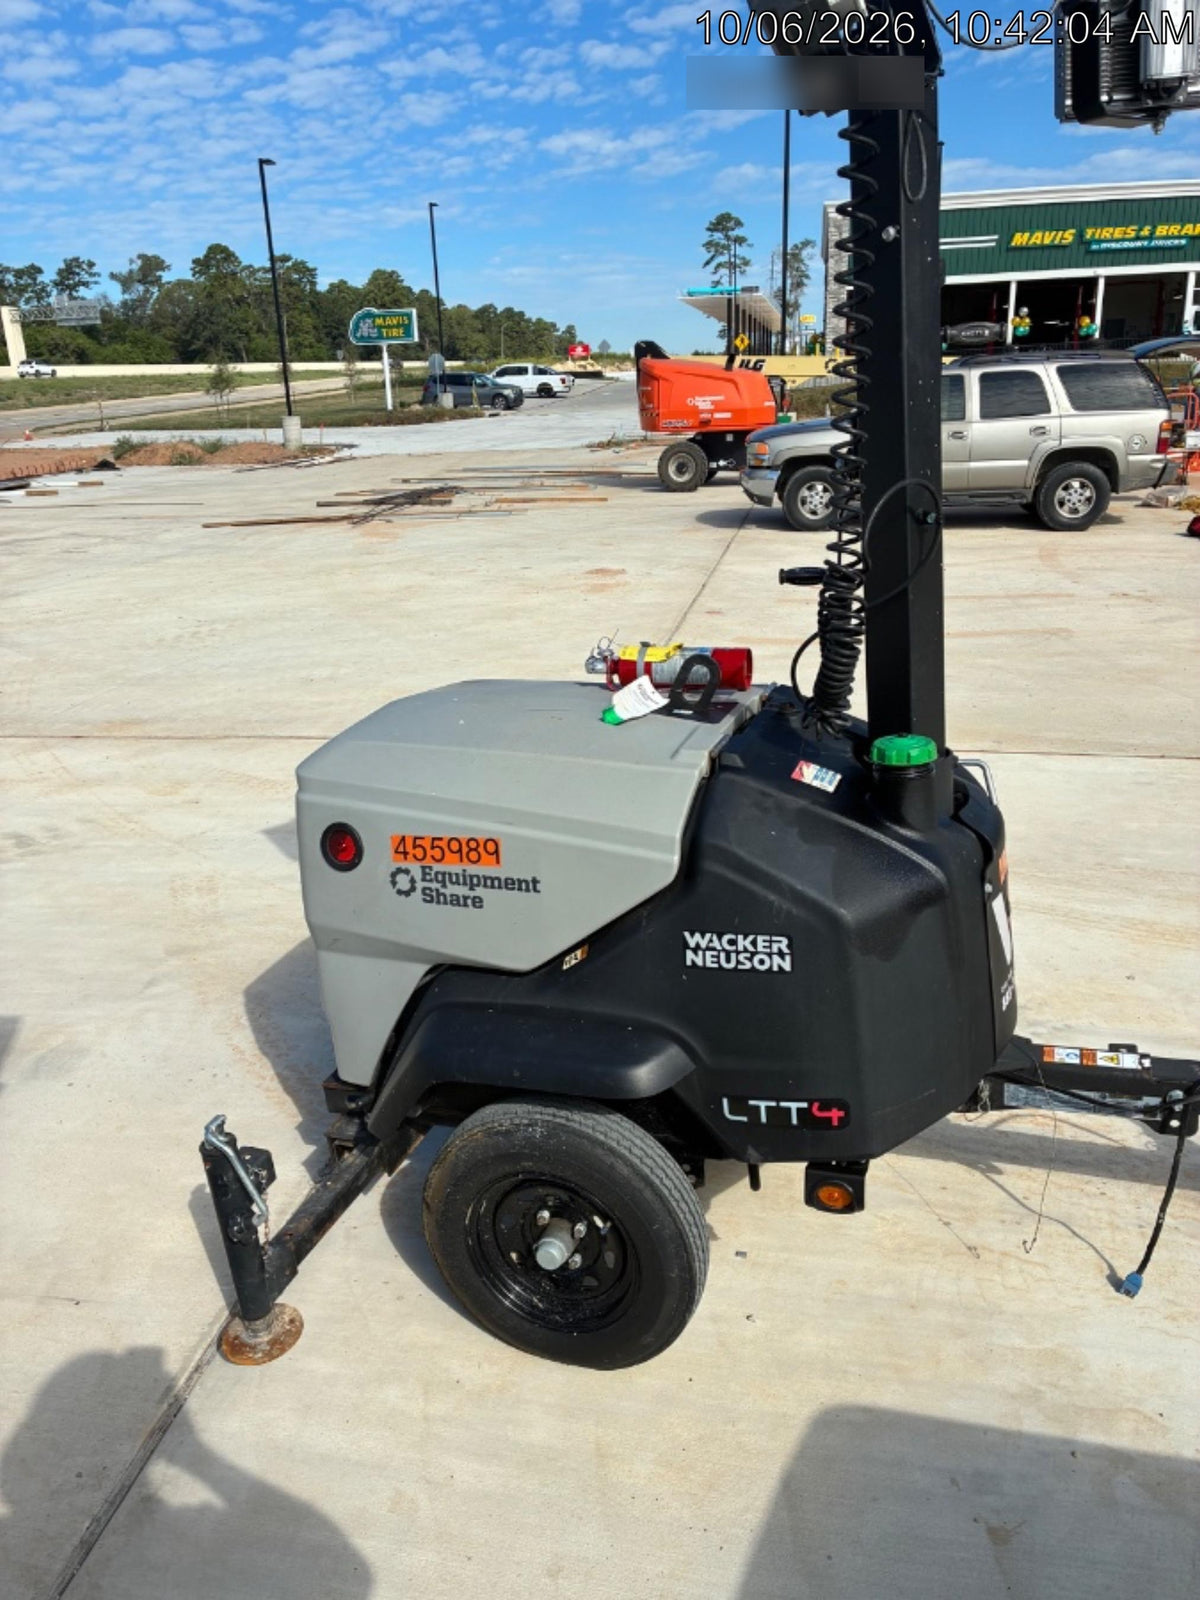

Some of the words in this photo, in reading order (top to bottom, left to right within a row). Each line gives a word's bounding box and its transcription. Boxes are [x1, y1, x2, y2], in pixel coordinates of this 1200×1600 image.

[1011, 229, 1076, 247] MAVIS
[1085, 226, 1138, 239] TIRES
[1140, 225, 1152, 236] &
[375, 316, 408, 326] MAVIS
[381, 327, 405, 338] TIRE
[394, 835, 500, 865] 455989
[420, 865, 541, 893] Equipment
[421, 886, 484, 909] Share
[683, 931, 790, 953] WACKER
[685, 949, 792, 972] NEUSON
[722, 1097, 845, 1126] LTT4
